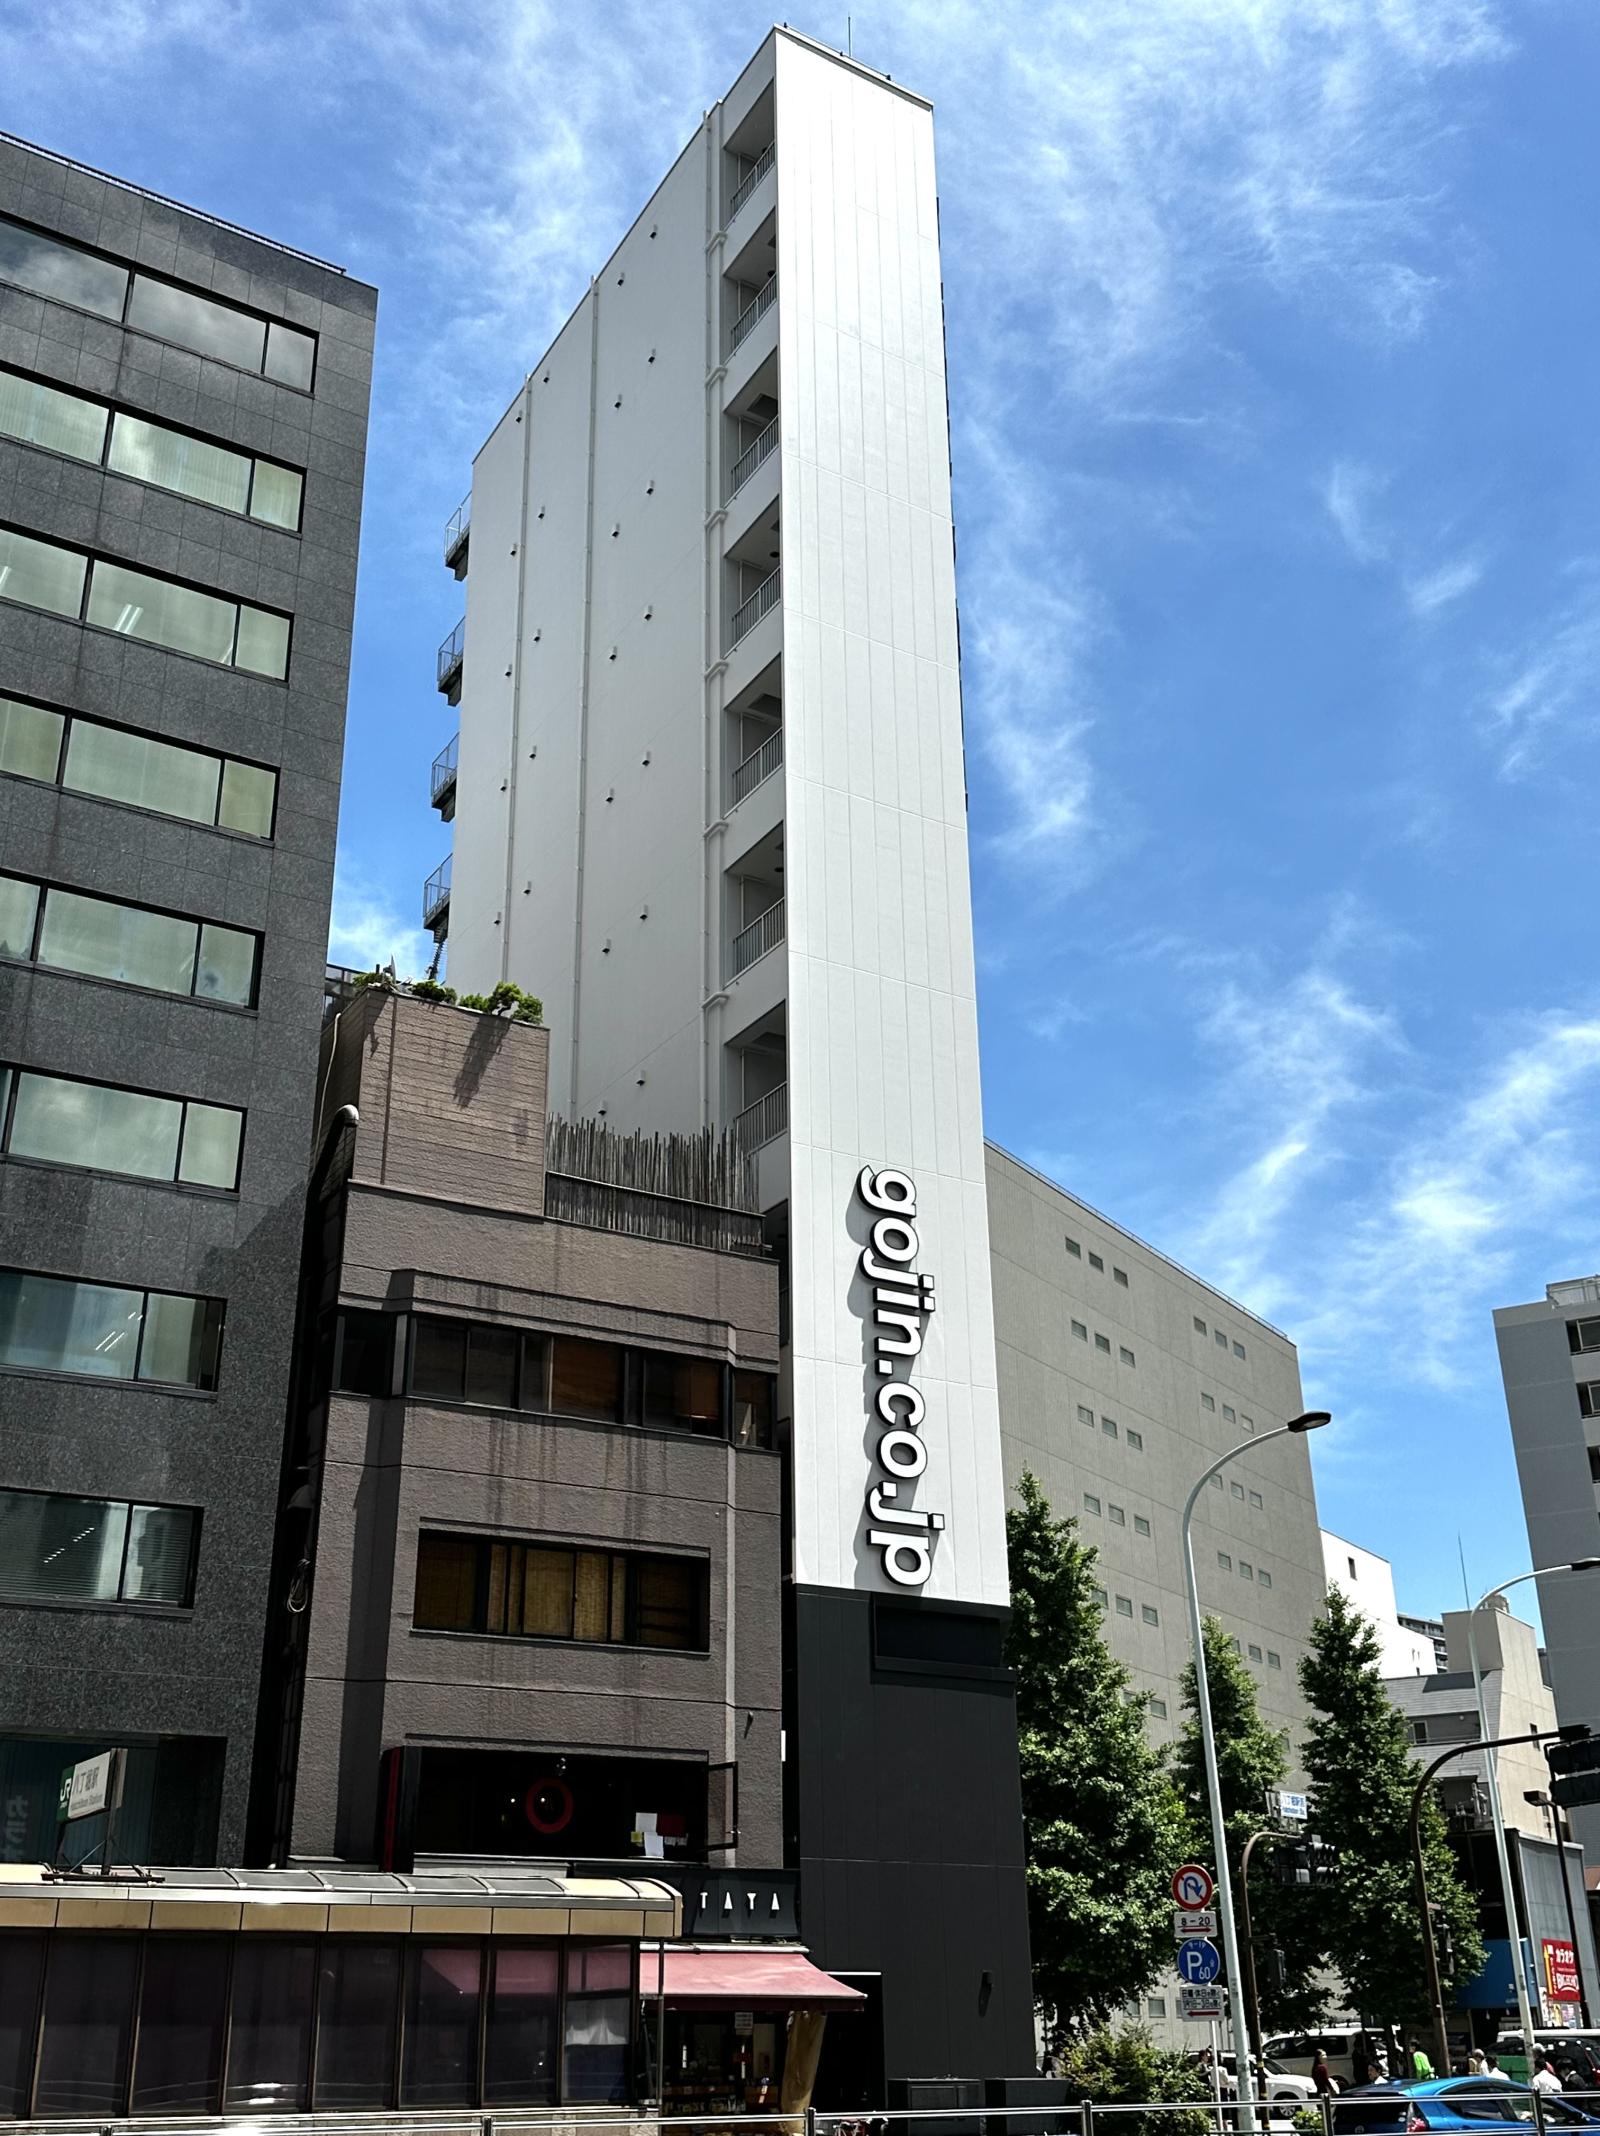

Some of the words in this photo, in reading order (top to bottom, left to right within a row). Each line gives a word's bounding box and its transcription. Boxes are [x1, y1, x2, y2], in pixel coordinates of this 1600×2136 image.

[857, 1165, 945, 1586] gojin.co.jp
[60, 1778, 72, 1801] JR
[700, 1891, 780, 1911] TAYA
[1186, 1951, 1203, 1980] P
